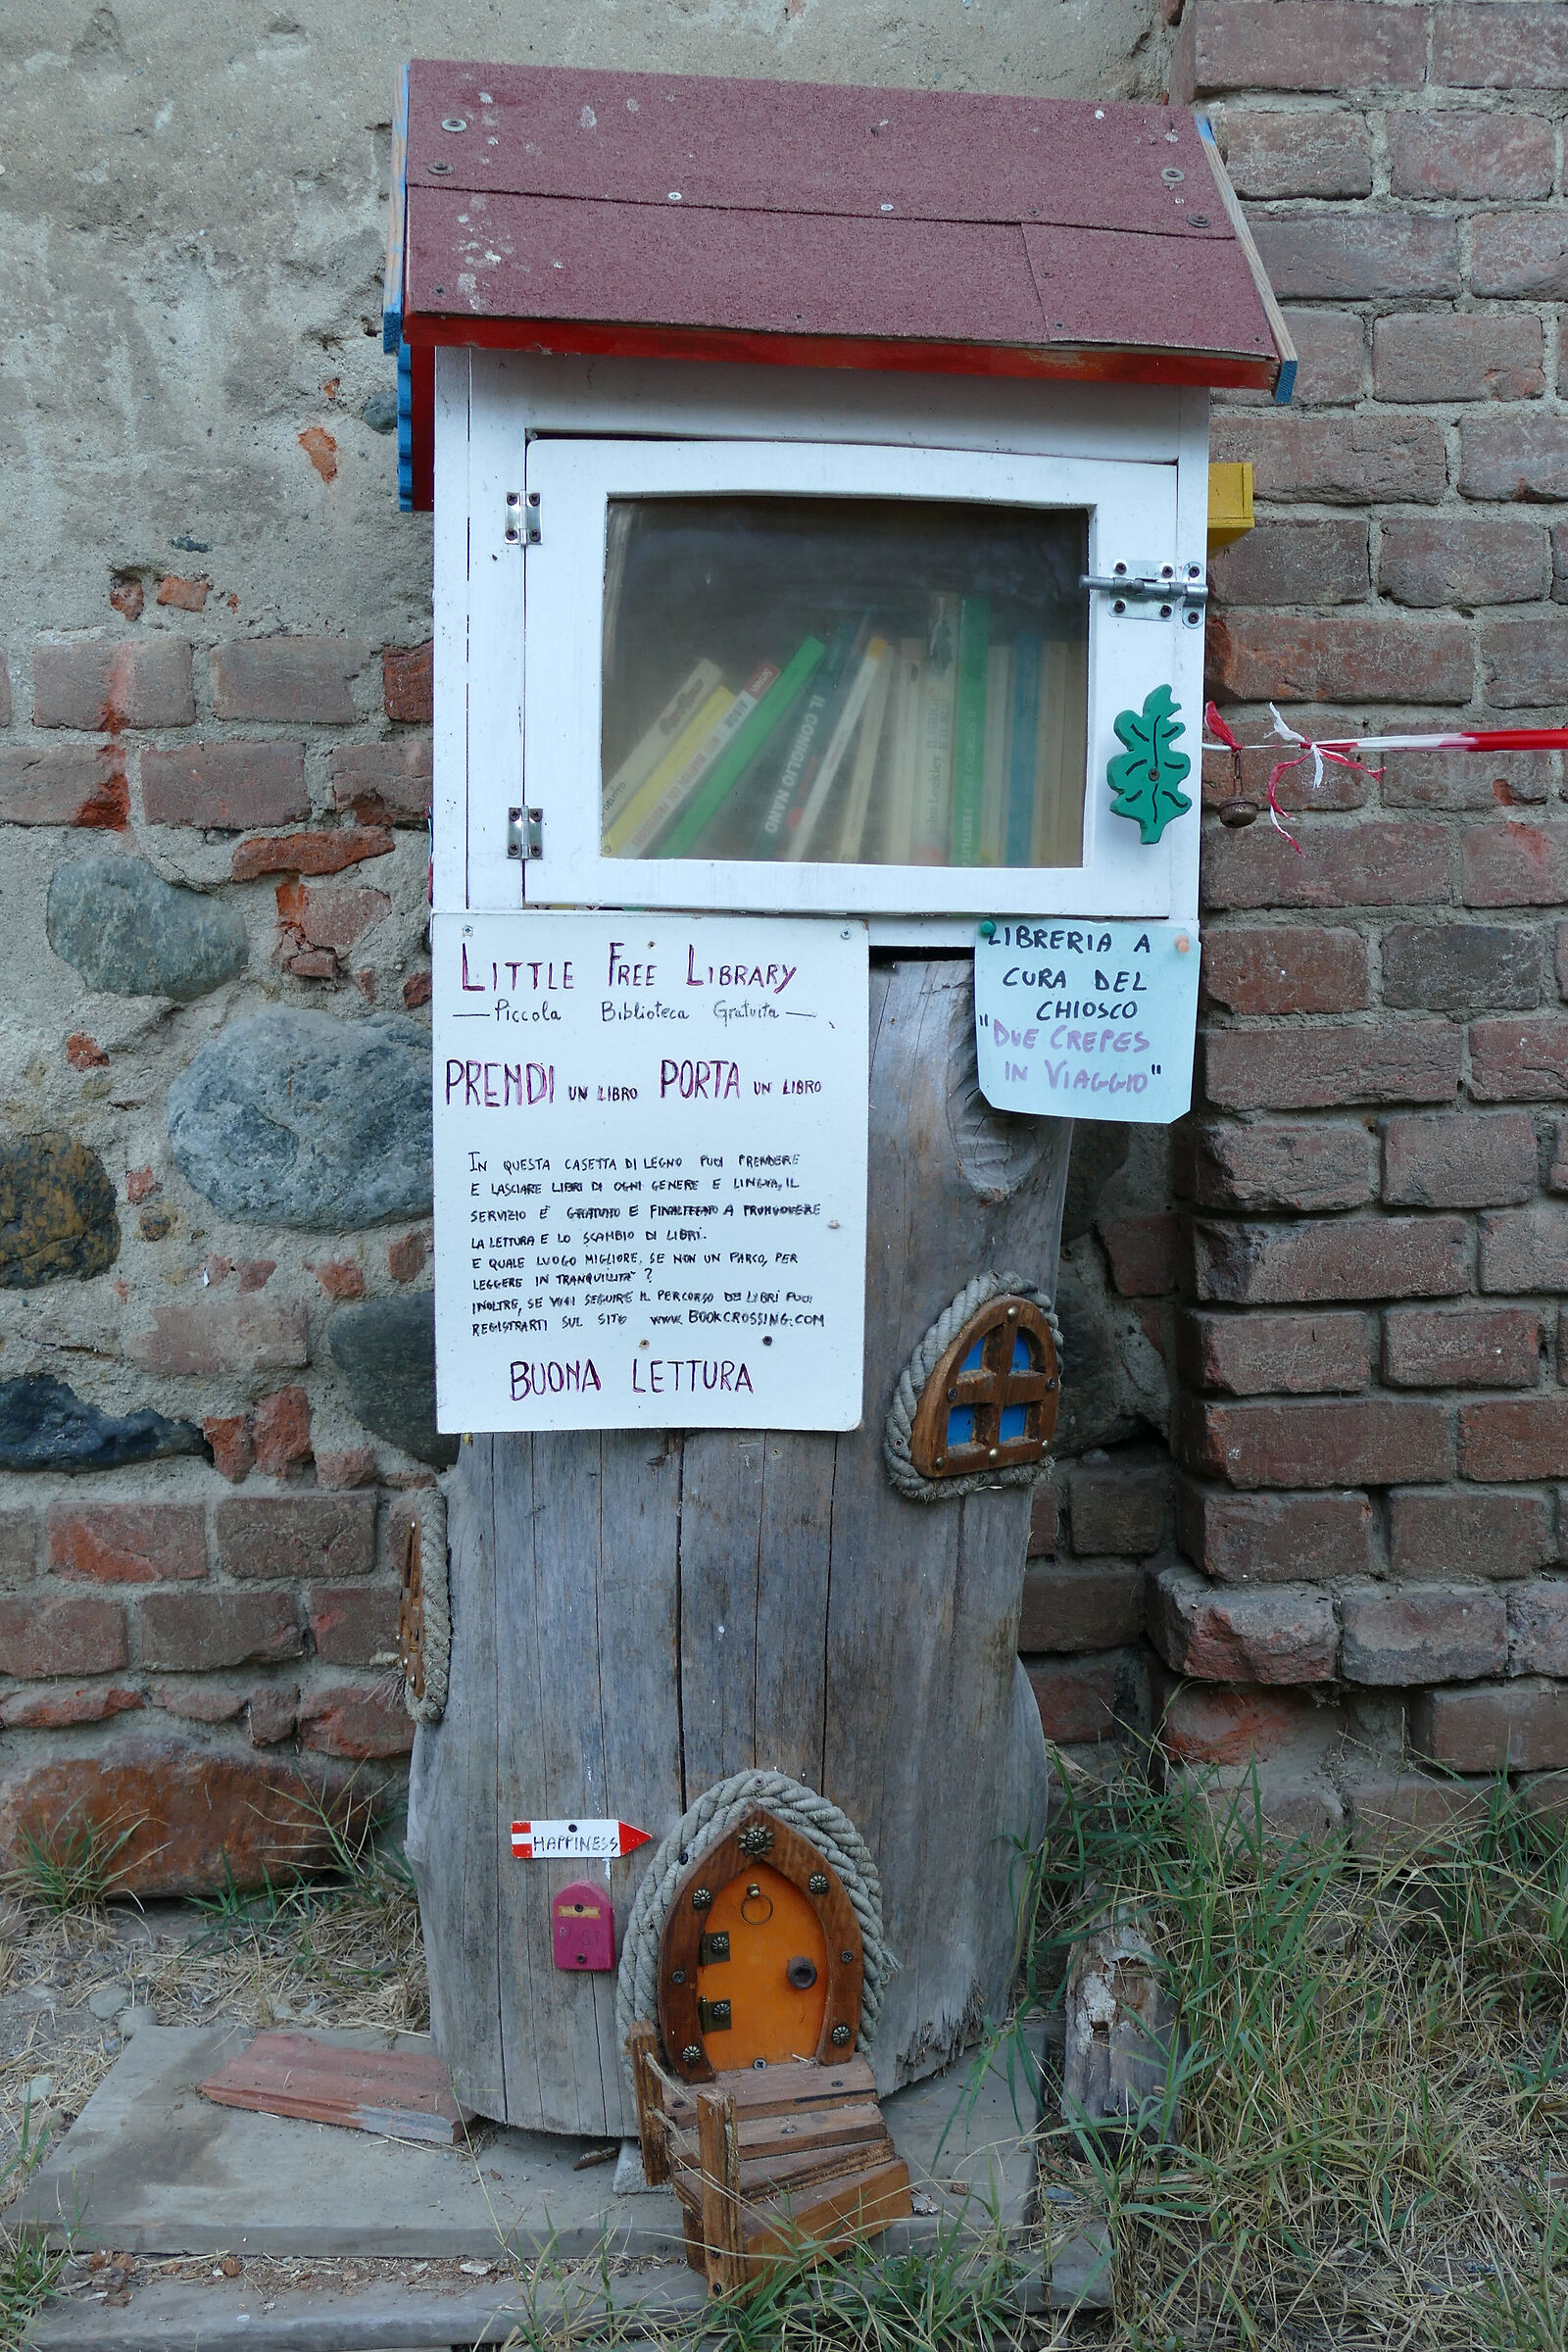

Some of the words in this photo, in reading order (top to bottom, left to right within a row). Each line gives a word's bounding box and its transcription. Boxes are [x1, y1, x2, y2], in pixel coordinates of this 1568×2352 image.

[808, 695, 826, 711] IL
[780, 710, 818, 787] CONIGLIO
[763, 785, 792, 834] NANO
[986, 923, 1111, 954] LIBRERIA
[1133, 934, 1151, 954] A
[463, 943, 574, 992] LITTLE
[609, 941, 658, 987] FREE
[1003, 967, 1066, 989] CURA
[1095, 969, 1149, 993] DEL
[495, 999, 562, 1023] Piccola
[601, 1001, 690, 1022] Biblioteca
[713, 1000, 779, 1027] Gratuita
[1036, 1001, 1138, 1021] CHIOSCO
[1051, 1025, 1150, 1054] CREPES
[1005, 1061, 1028, 1081] IN
[446, 1059, 555, 1107] PRENDI
[567, 1085, 588, 1102] UN
[597, 1085, 640, 1102] LIBRO
[661, 1059, 740, 1100] PORTA
[754, 1081, 772, 1096] UN
[782, 1078, 822, 1095] LIBRO
[504, 1157, 550, 1176] QUESTA
[564, 1157, 618, 1172] CASETTA
[623, 1157, 637, 1172] DI
[644, 1156, 682, 1169] LEGNO
[700, 1154, 723, 1168] PUOI
[739, 1153, 800, 1169] PRENDERE
[470, 1181, 481, 1197] E
[491, 1183, 542, 1198] LASCIARE
[552, 1182, 583, 1195] LIBRI
[591, 1181, 603, 1192] DI
[613, 1180, 644, 1192] OGNI
[652, 1179, 699, 1192] GENERE
[712, 1178, 721, 1191] E
[786, 1177, 800, 1188] IL
[470, 1209, 526, 1223] SERVIZIO
[627, 1204, 639, 1217] E
[722, 1203, 734, 1216] A
[471, 1237, 486, 1250] LA
[489, 1235, 535, 1249] LETTURA
[540, 1232, 549, 1245] E
[558, 1232, 571, 1244] LO
[583, 1230, 634, 1247] SCAMBIO
[644, 1231, 657, 1243] DI
[471, 1258, 481, 1269] E
[487, 1257, 525, 1271] QUALE
[536, 1254, 576, 1269] LUOGO
[650, 1252, 666, 1264] SE
[673, 1253, 696, 1264] NON
[704, 1253, 720, 1264] UN
[775, 1251, 798, 1264] PER
[473, 1277, 523, 1293] LEGGERE
[535, 1272, 549, 1287] IN
[527, 1297, 543, 1309] SE
[584, 1291, 633, 1306] SEGUIRE
[658, 1290, 713, 1304] PERCORSO
[470, 1319, 547, 1337] REGISTRARTI
[562, 1315, 583, 1329] SUL
[598, 1311, 627, 1325] SITO
[510, 1358, 601, 1401] BUONA
[632, 1358, 754, 1394] LETTURA
[533, 1836, 618, 1852] HAPPINESS
